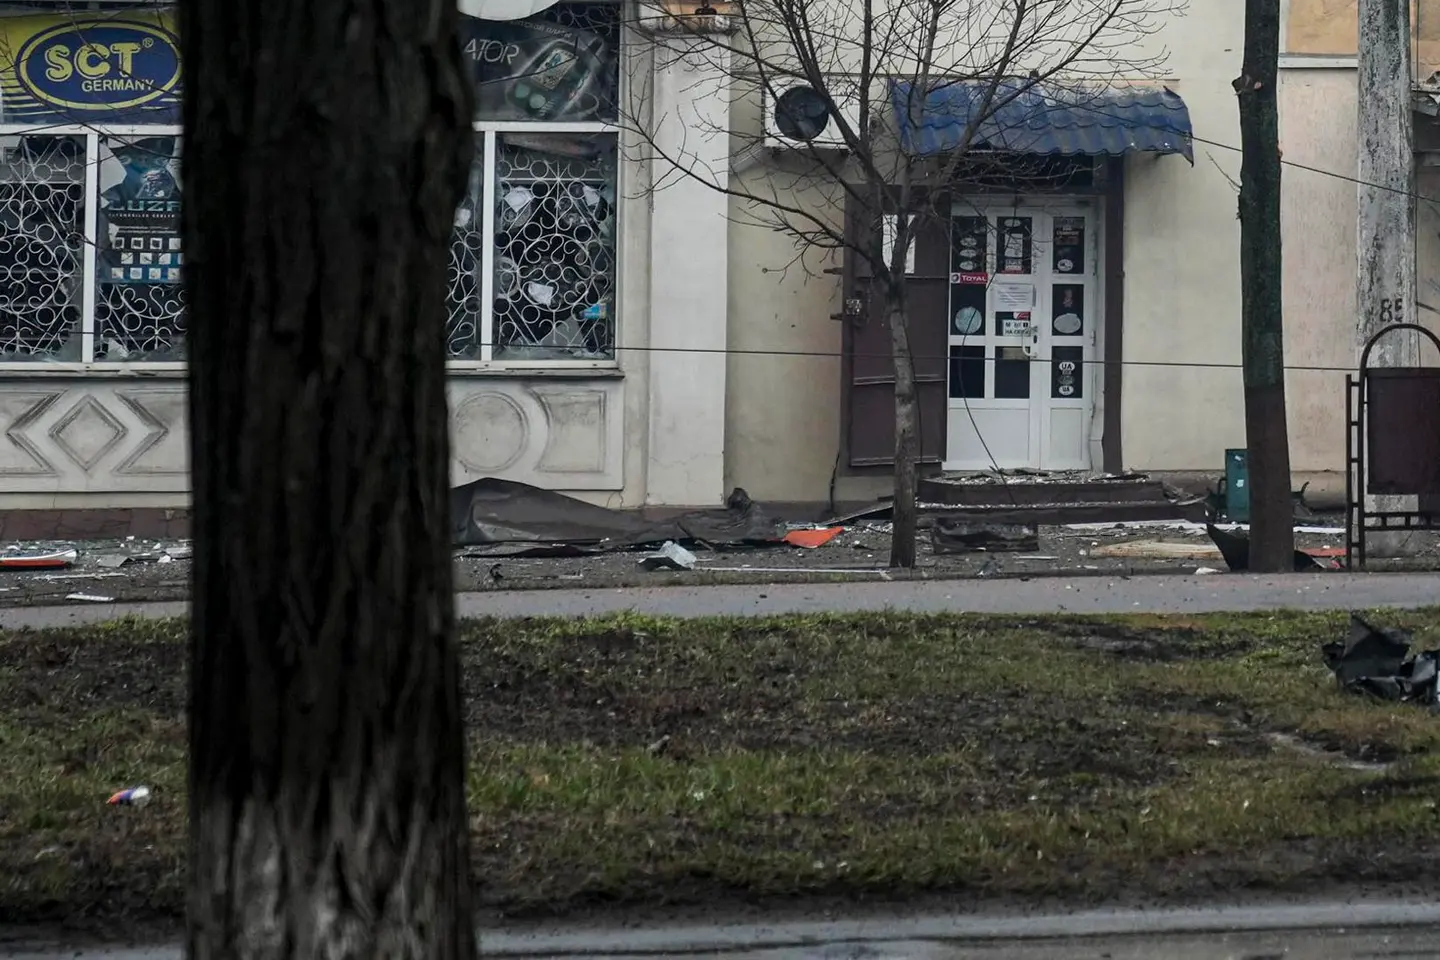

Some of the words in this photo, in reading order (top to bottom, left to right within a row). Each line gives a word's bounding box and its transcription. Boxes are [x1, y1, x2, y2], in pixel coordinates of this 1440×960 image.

[44, 42, 141, 82] SCT
[463, 38, 520, 64] ATOR
[81, 79, 154, 92] GERMANY
